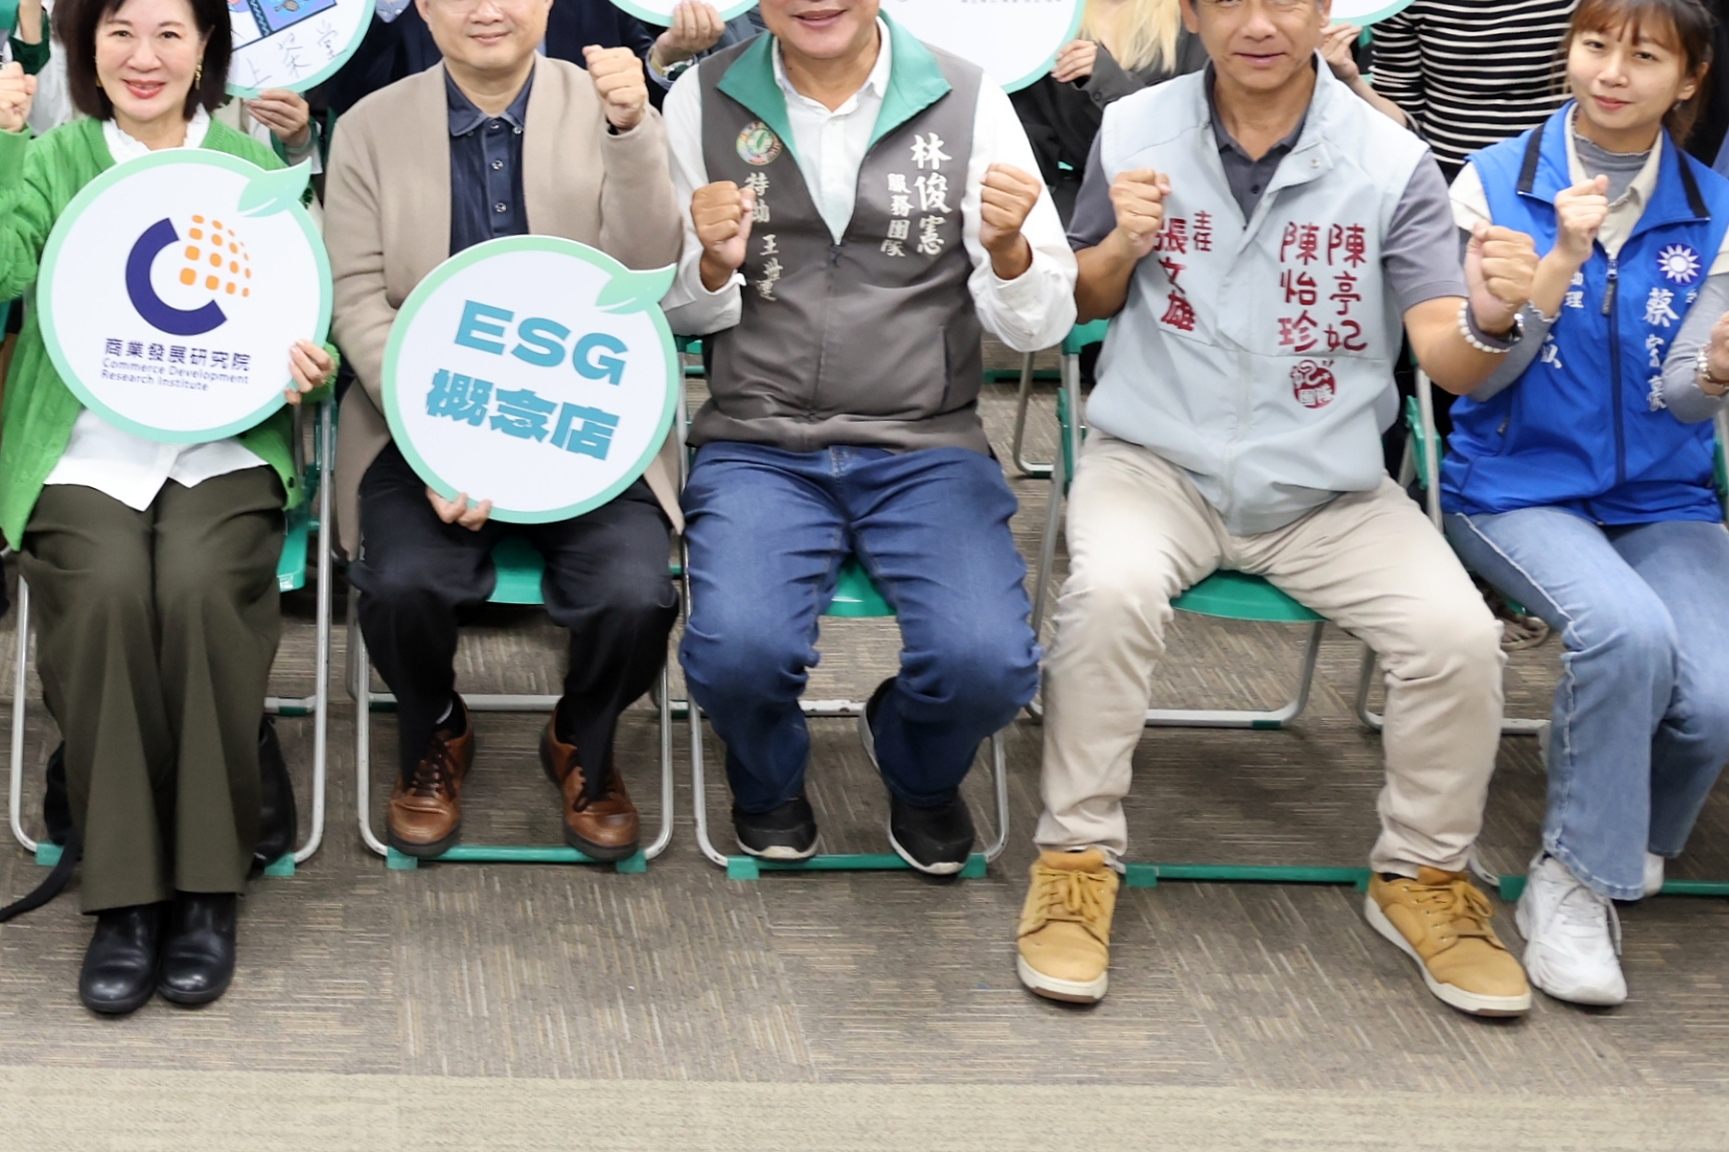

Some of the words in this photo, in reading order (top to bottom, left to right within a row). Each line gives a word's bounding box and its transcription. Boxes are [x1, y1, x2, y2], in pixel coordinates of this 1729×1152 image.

[880, 172, 916, 258] 服務團隊
[910, 132, 953, 256] 林俊憲
[1192, 209, 1214, 253] 主任
[1153, 216, 1197, 332] 張文雄
[1276, 221, 1321, 352] 陳怡珍
[1323, 222, 1369, 353] 陳亭妃
[100, 368, 155, 385] Research
[157, 375, 210, 392] Institute
[101, 356, 166, 376] Commerce
[167, 364, 250, 385] Development
[104, 338, 252, 372] 商業發展研究院
[454, 299, 630, 387] ESG
[425, 367, 621, 462] 概念店
